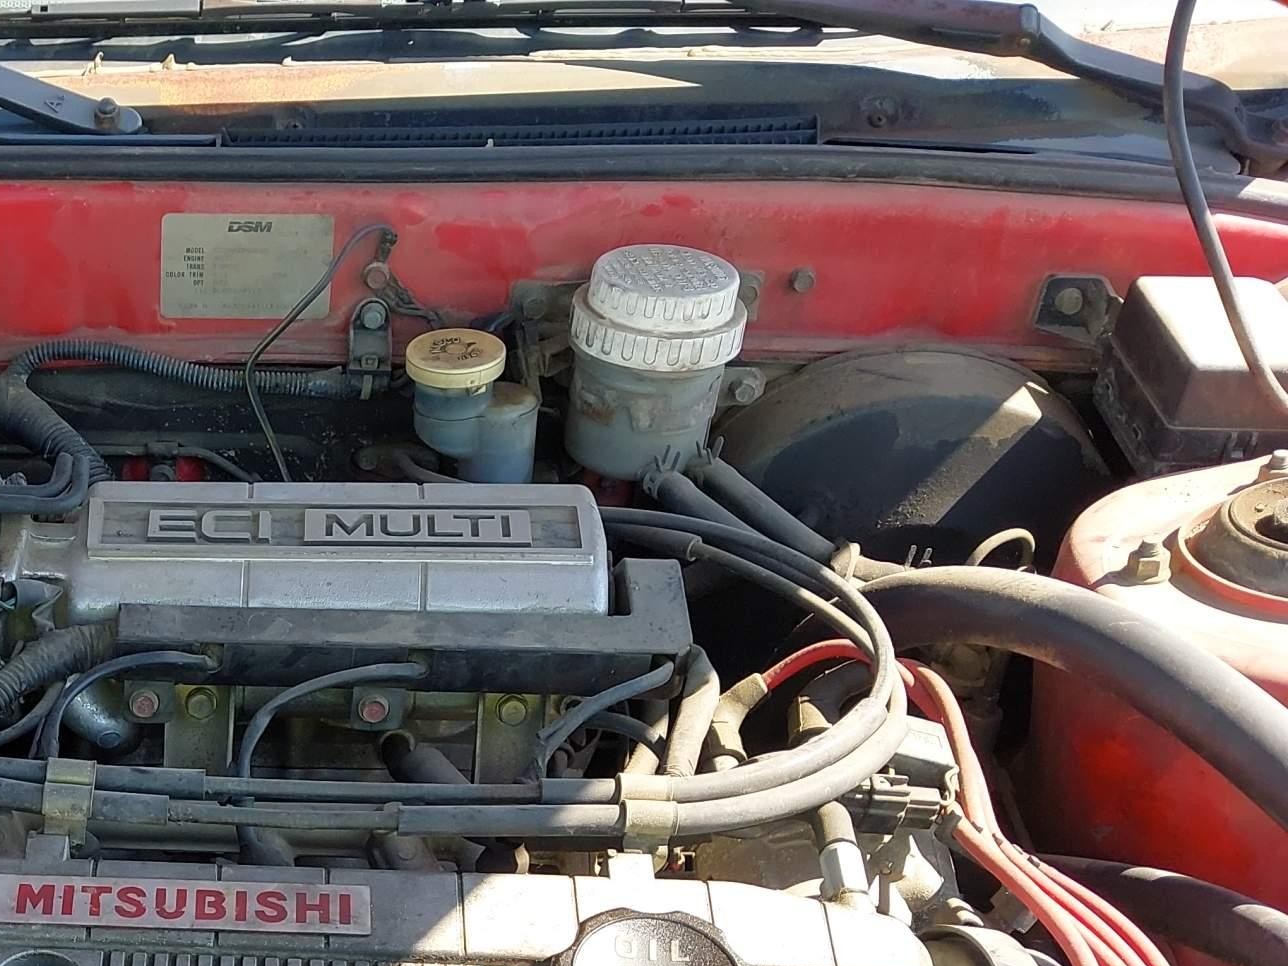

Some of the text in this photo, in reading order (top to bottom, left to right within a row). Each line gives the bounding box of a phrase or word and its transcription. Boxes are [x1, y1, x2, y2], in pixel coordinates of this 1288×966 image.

[227, 221, 273, 233] DSM
[192, 279, 204, 287] OPT
[146, 508, 513, 544] ECI MULTI
[15, 883, 352, 925] MITSUBISHI
[615, 937, 690, 961] OIL
